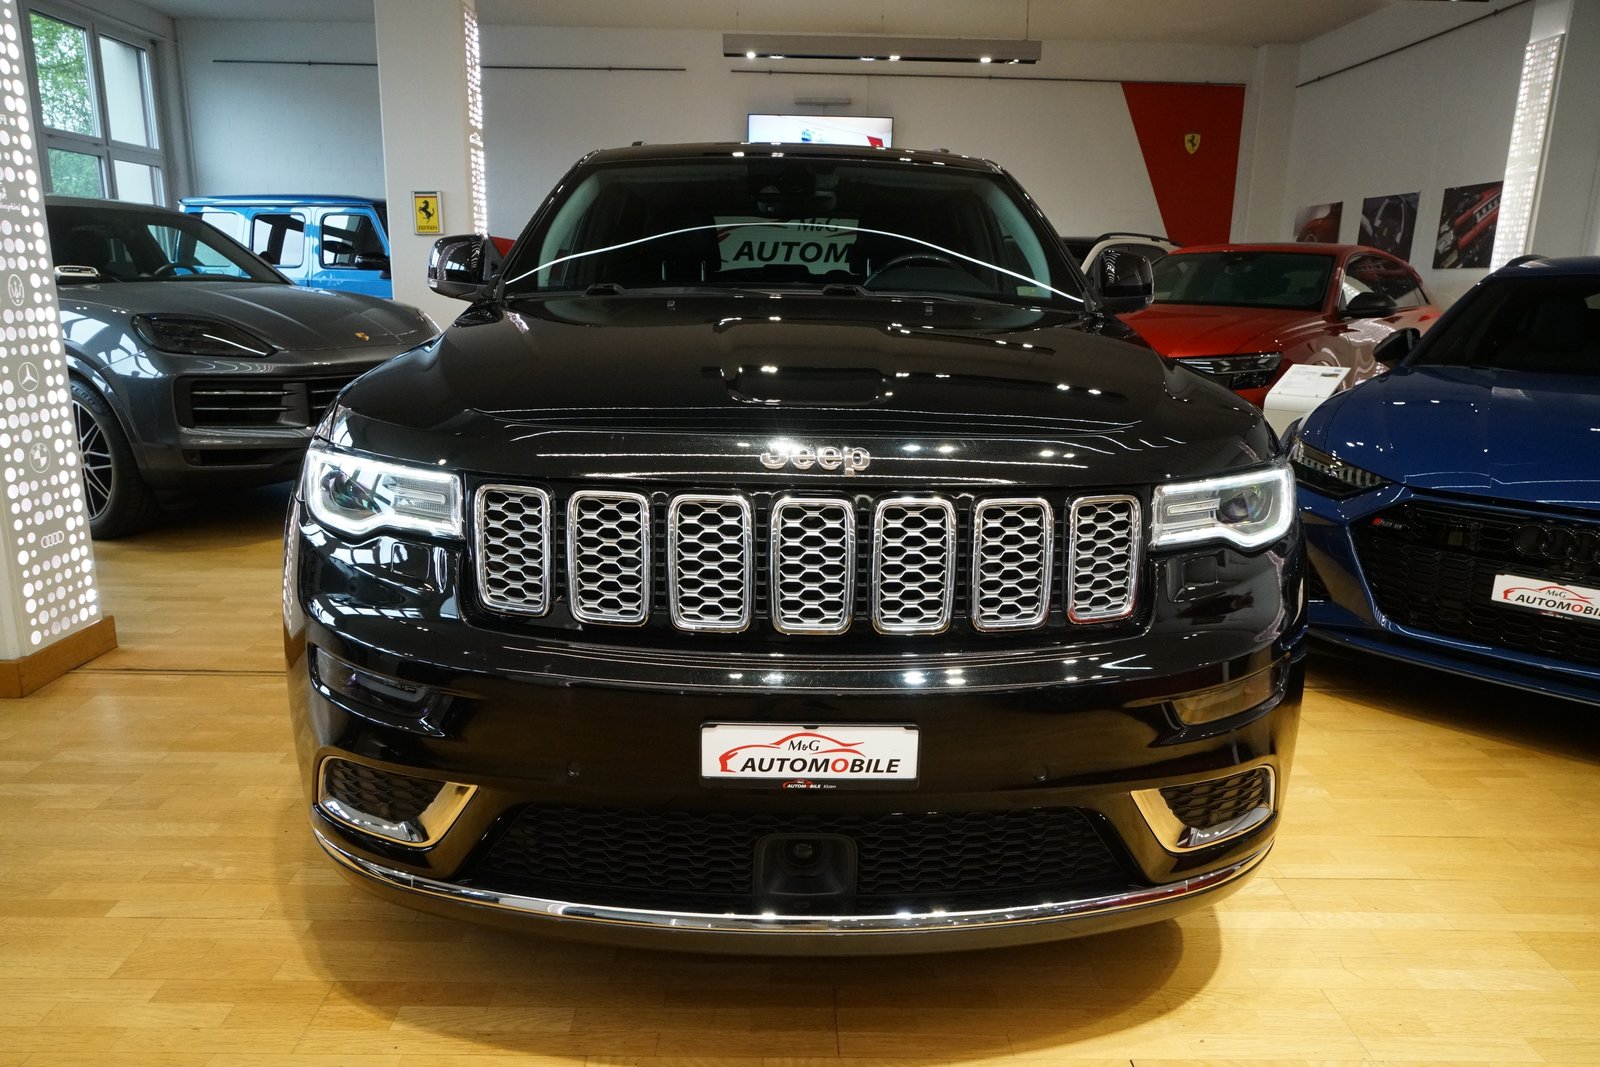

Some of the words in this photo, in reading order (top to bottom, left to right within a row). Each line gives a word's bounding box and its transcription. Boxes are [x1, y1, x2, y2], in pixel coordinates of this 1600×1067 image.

[760, 440, 871, 477] Jeep
[1515, 594, 1600, 616] AUTOMOBI
[788, 740, 821, 751] M&G
[740, 757, 901, 773] AUTOMOBILE
